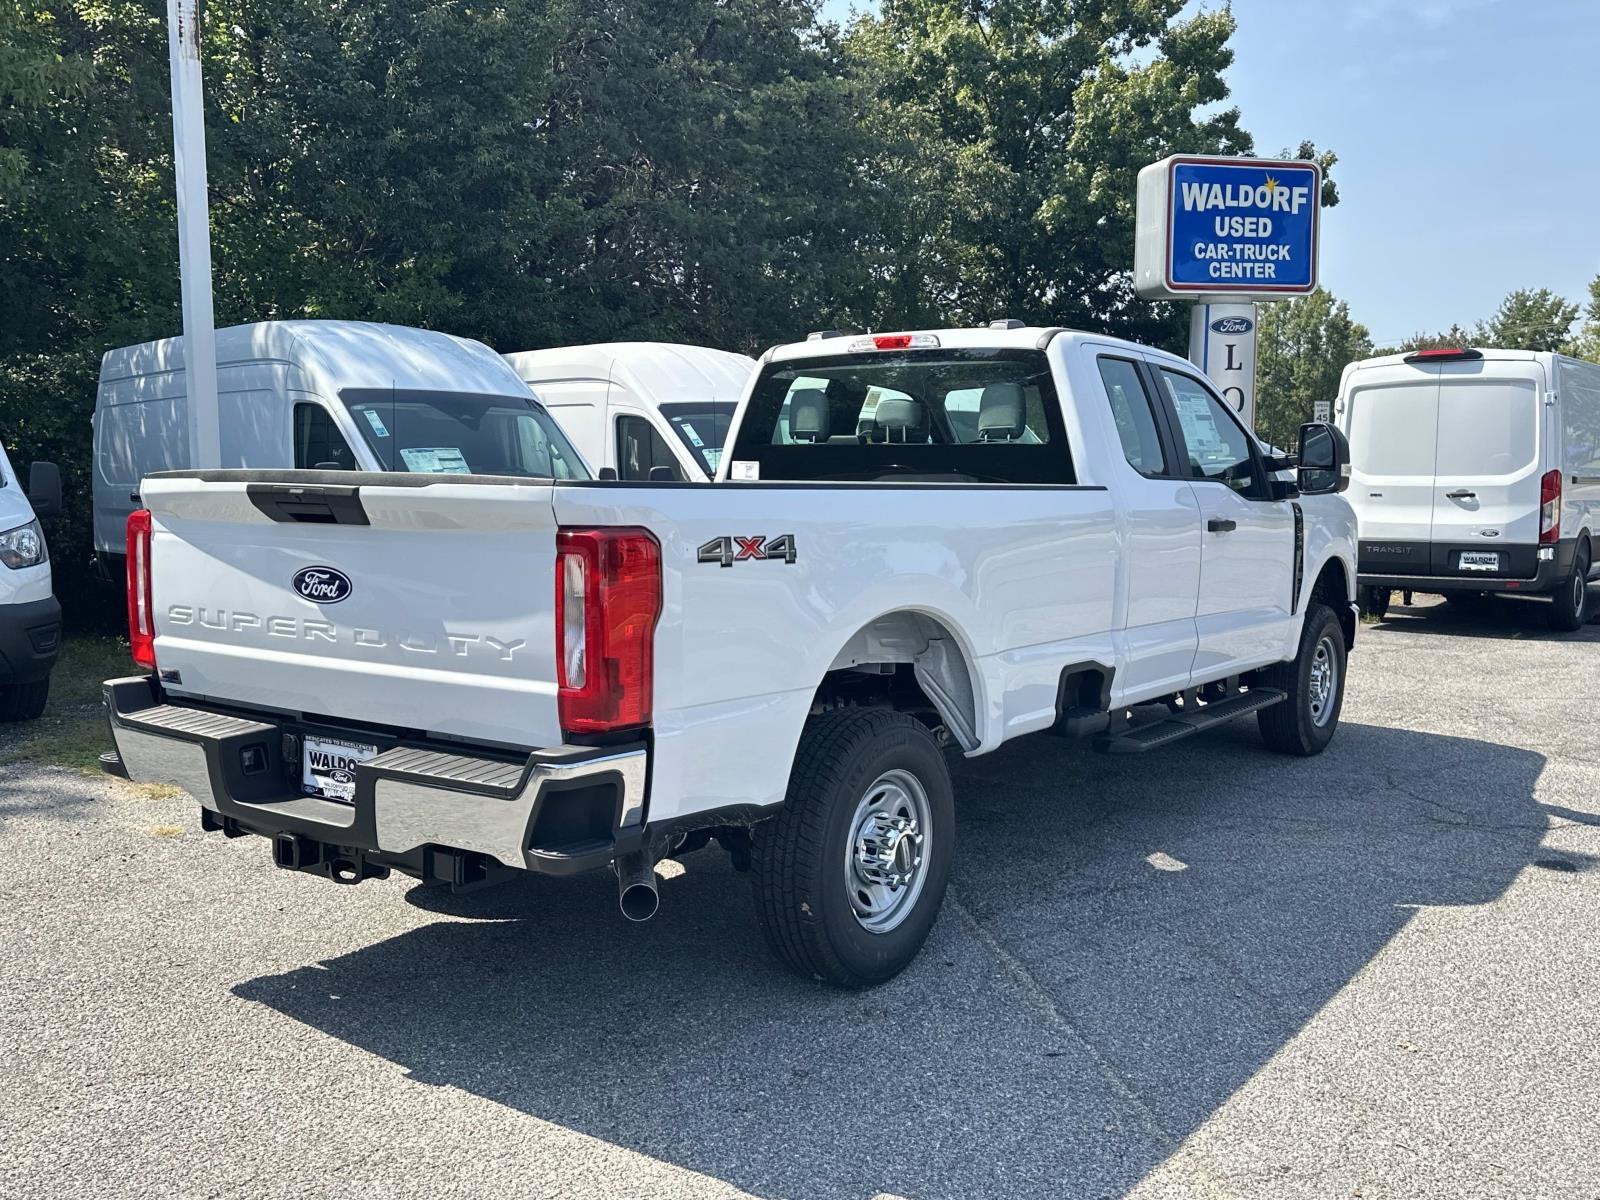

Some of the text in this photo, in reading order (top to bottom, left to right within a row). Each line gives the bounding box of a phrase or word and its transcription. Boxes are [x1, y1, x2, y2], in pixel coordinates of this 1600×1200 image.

[1181, 182, 1309, 214] WALDORF
[1215, 216, 1273, 238] USED
[1194, 242, 1291, 261] CAR-TRUCK
[1209, 262, 1276, 279] CENTER
[1220, 319, 1247, 332] Ford
[1316, 413, 1328, 422] 45
[1366, 546, 1412, 554] TRANSIT
[301, 571, 340, 598] Ford
[168, 604, 527, 661] SUPER DUTY
[305, 735, 332, 744] DEDICATED
[340, 741, 372, 751] EXCELLENCE
[309, 751, 358, 773] WALDO
[333, 771, 348, 783] Ford
